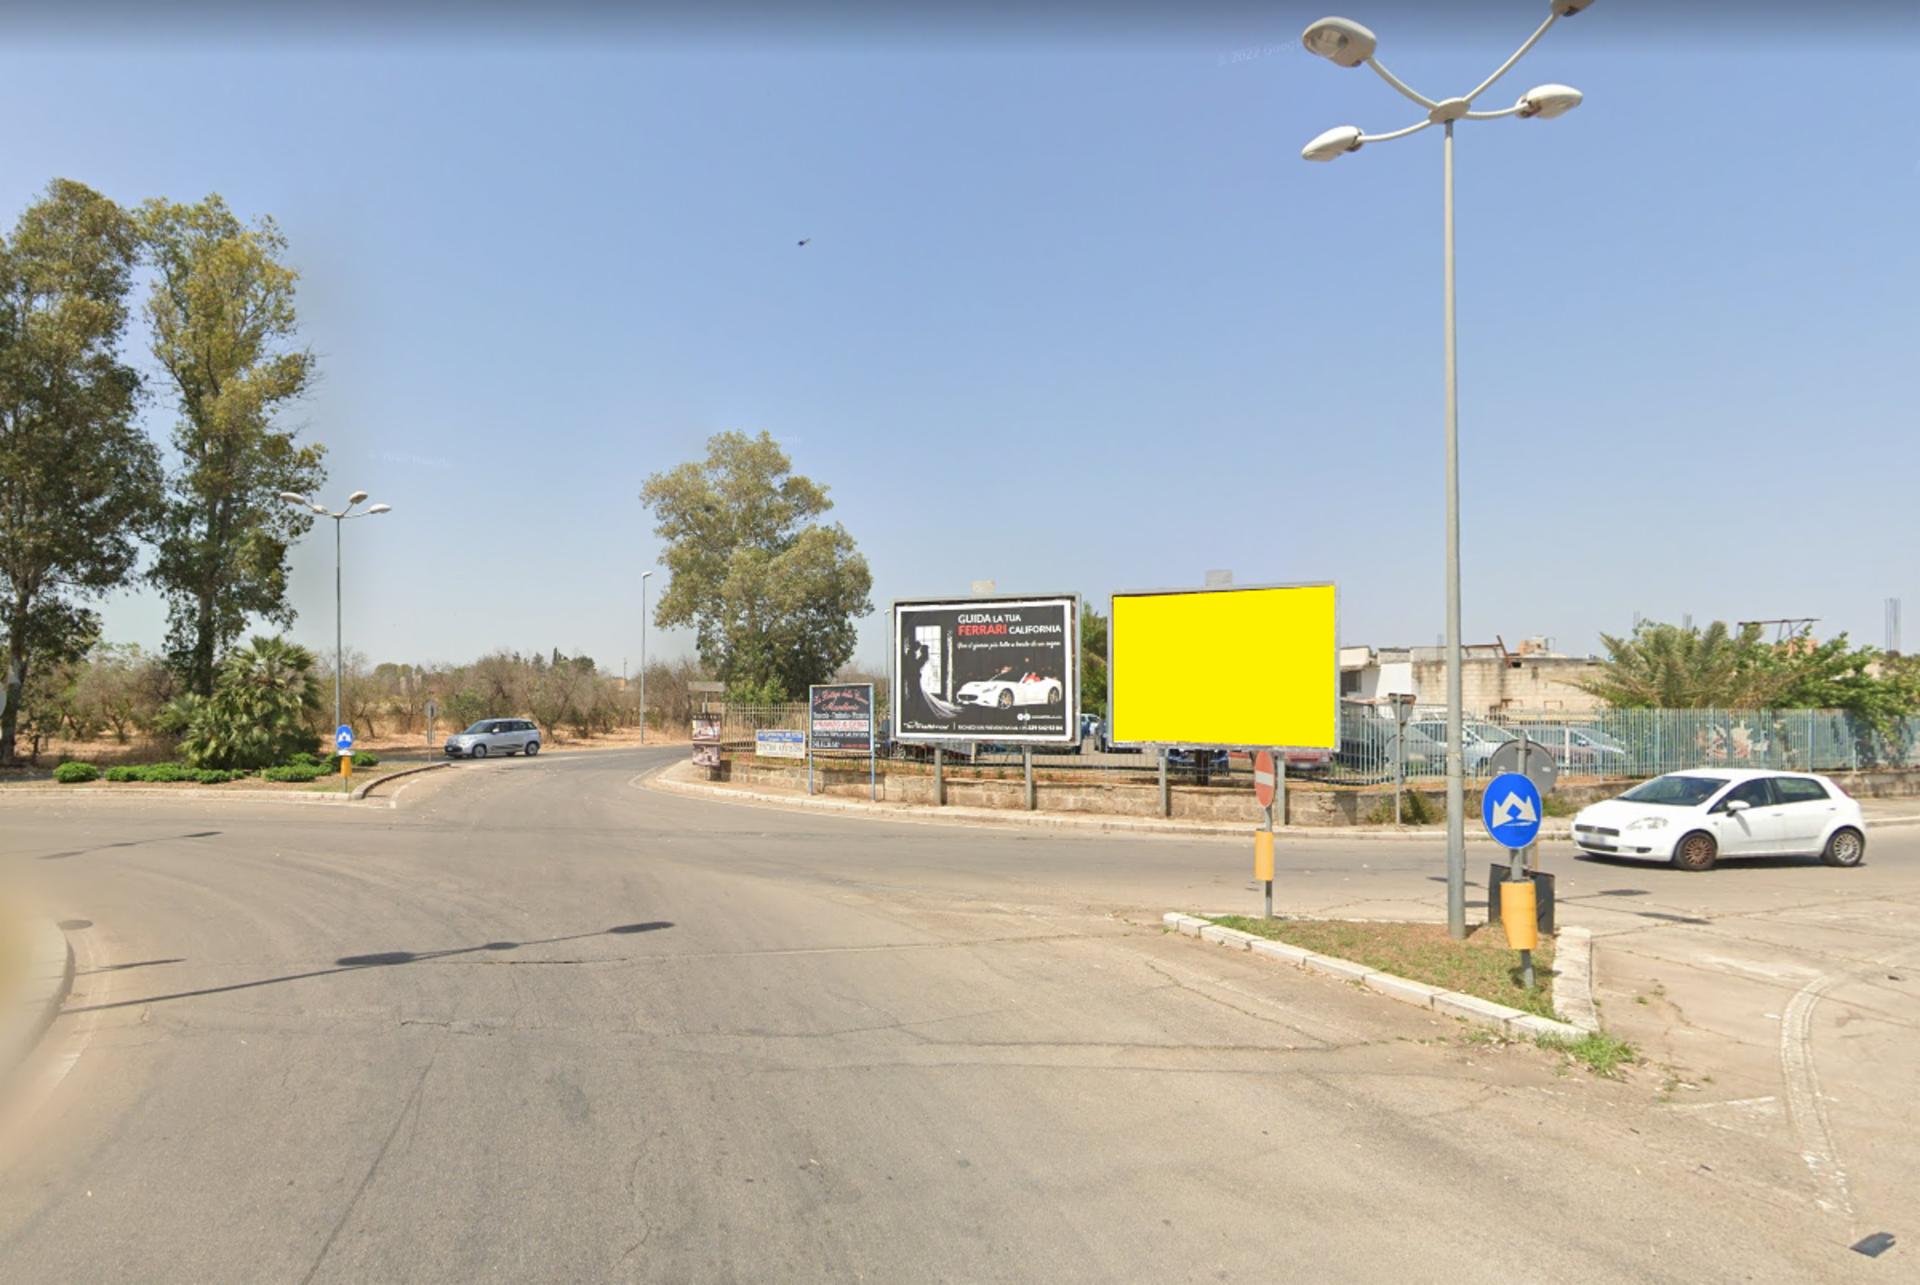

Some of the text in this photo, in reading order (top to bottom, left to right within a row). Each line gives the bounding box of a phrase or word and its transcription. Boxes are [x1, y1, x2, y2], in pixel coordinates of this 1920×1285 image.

[958, 614, 1022, 624] GUIDA LA TUA
[957, 623, 1062, 636] FERRARI CALIFORNIA
